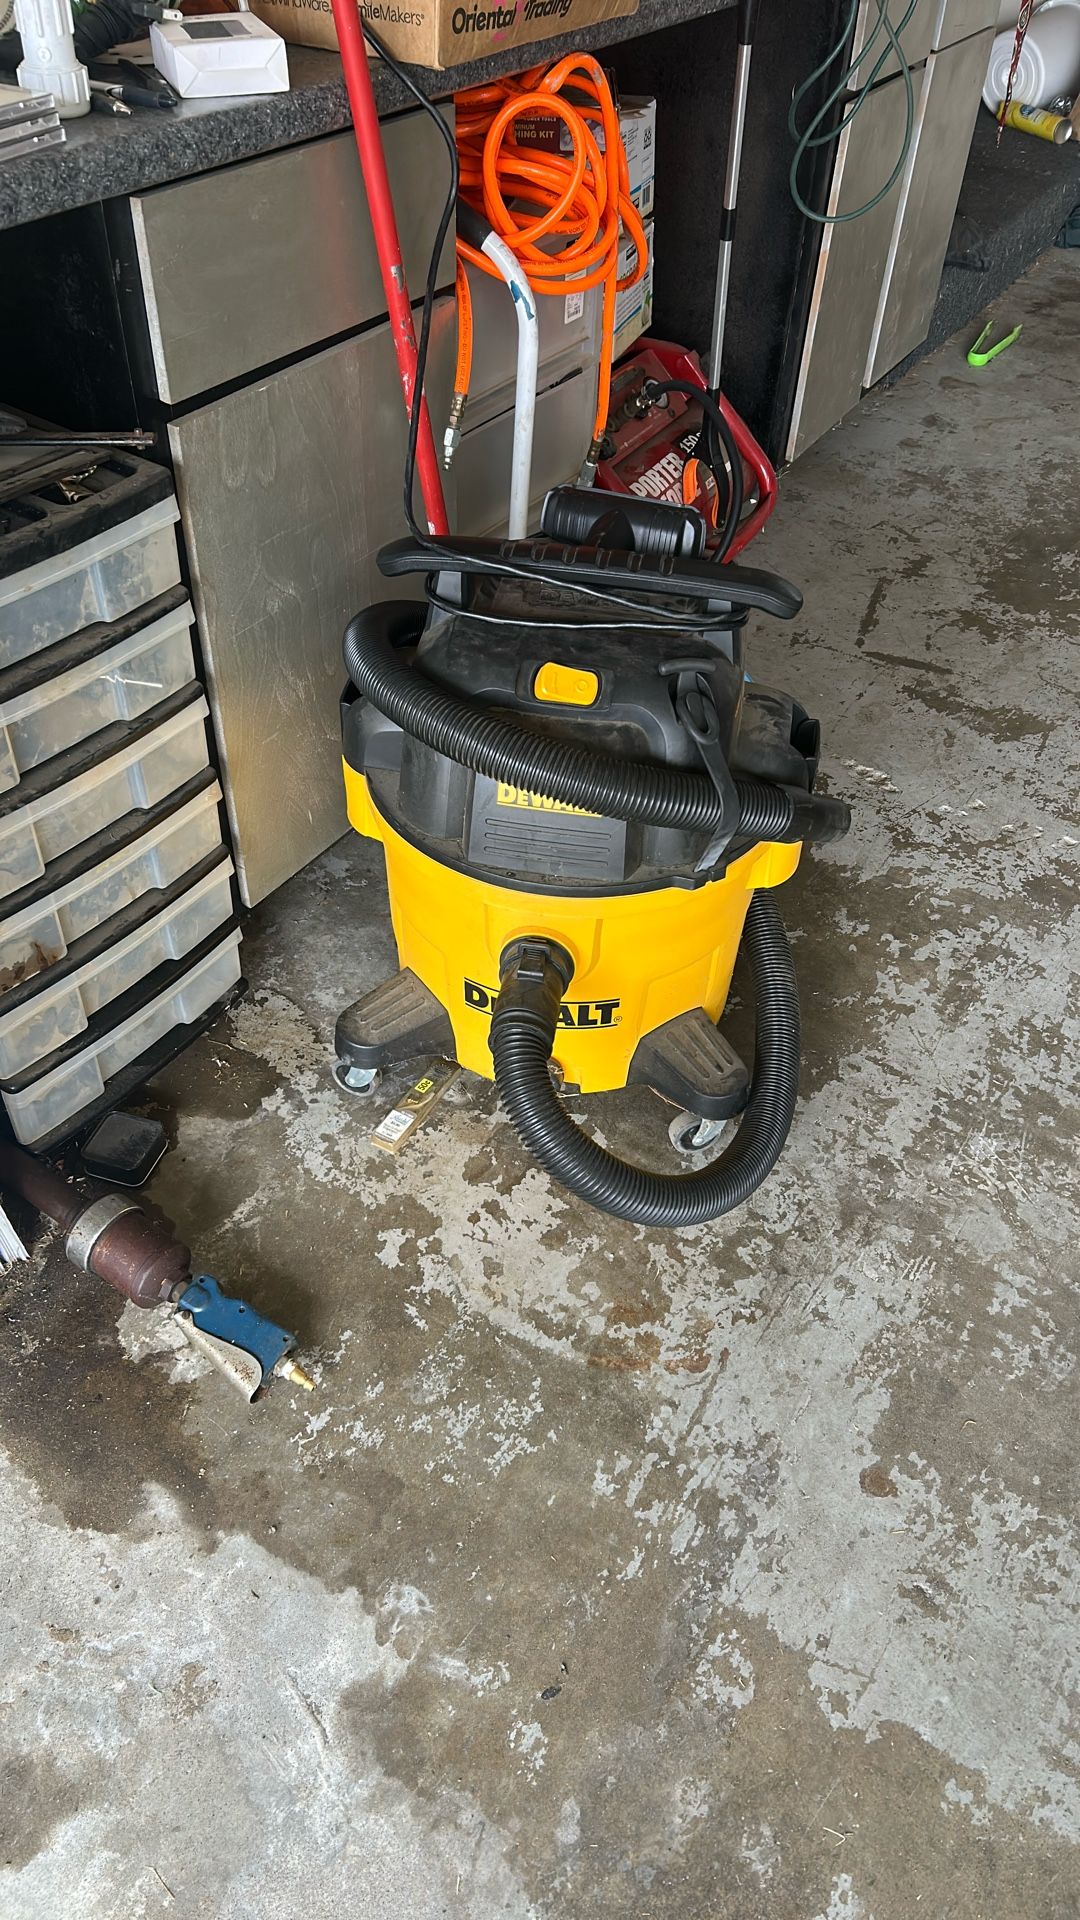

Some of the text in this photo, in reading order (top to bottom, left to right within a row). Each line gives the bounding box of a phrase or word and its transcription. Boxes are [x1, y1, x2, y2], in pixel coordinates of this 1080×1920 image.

[452, 0, 571, 35] Oriental Trading
[514, 130, 555, 139] HING KIT
[680, 433, 699, 454] 150
[629, 452, 684, 498] PORTER
[497, 780, 601, 815] DEW
